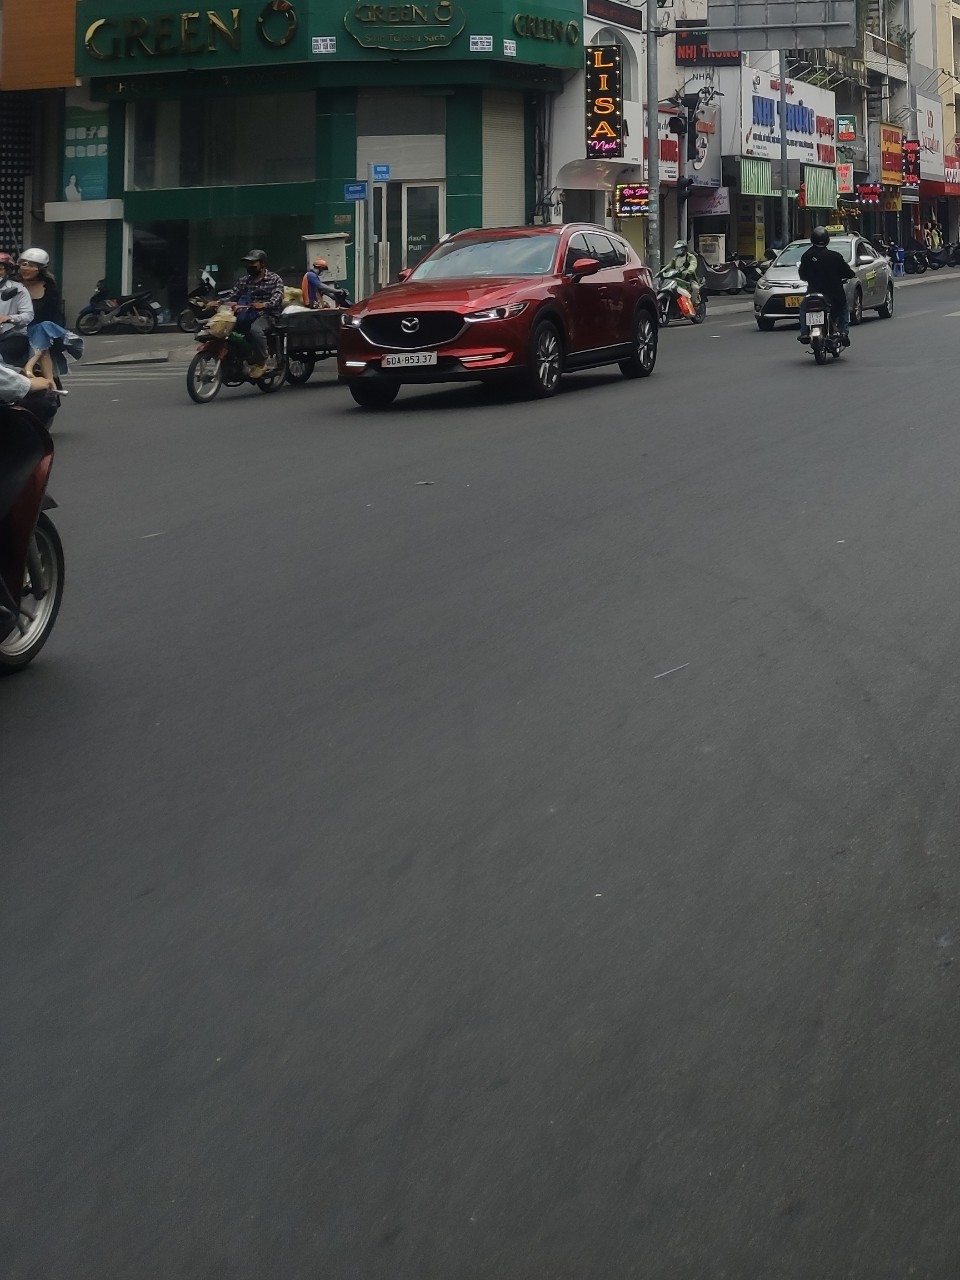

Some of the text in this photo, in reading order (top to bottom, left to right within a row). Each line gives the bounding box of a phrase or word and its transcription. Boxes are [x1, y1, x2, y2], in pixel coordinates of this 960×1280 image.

[84, 7, 241, 62] GREEN
[354, 4, 429, 23] GREEN
[512, 13, 563, 43] GREEN
[591, 51, 617, 138] LISA
